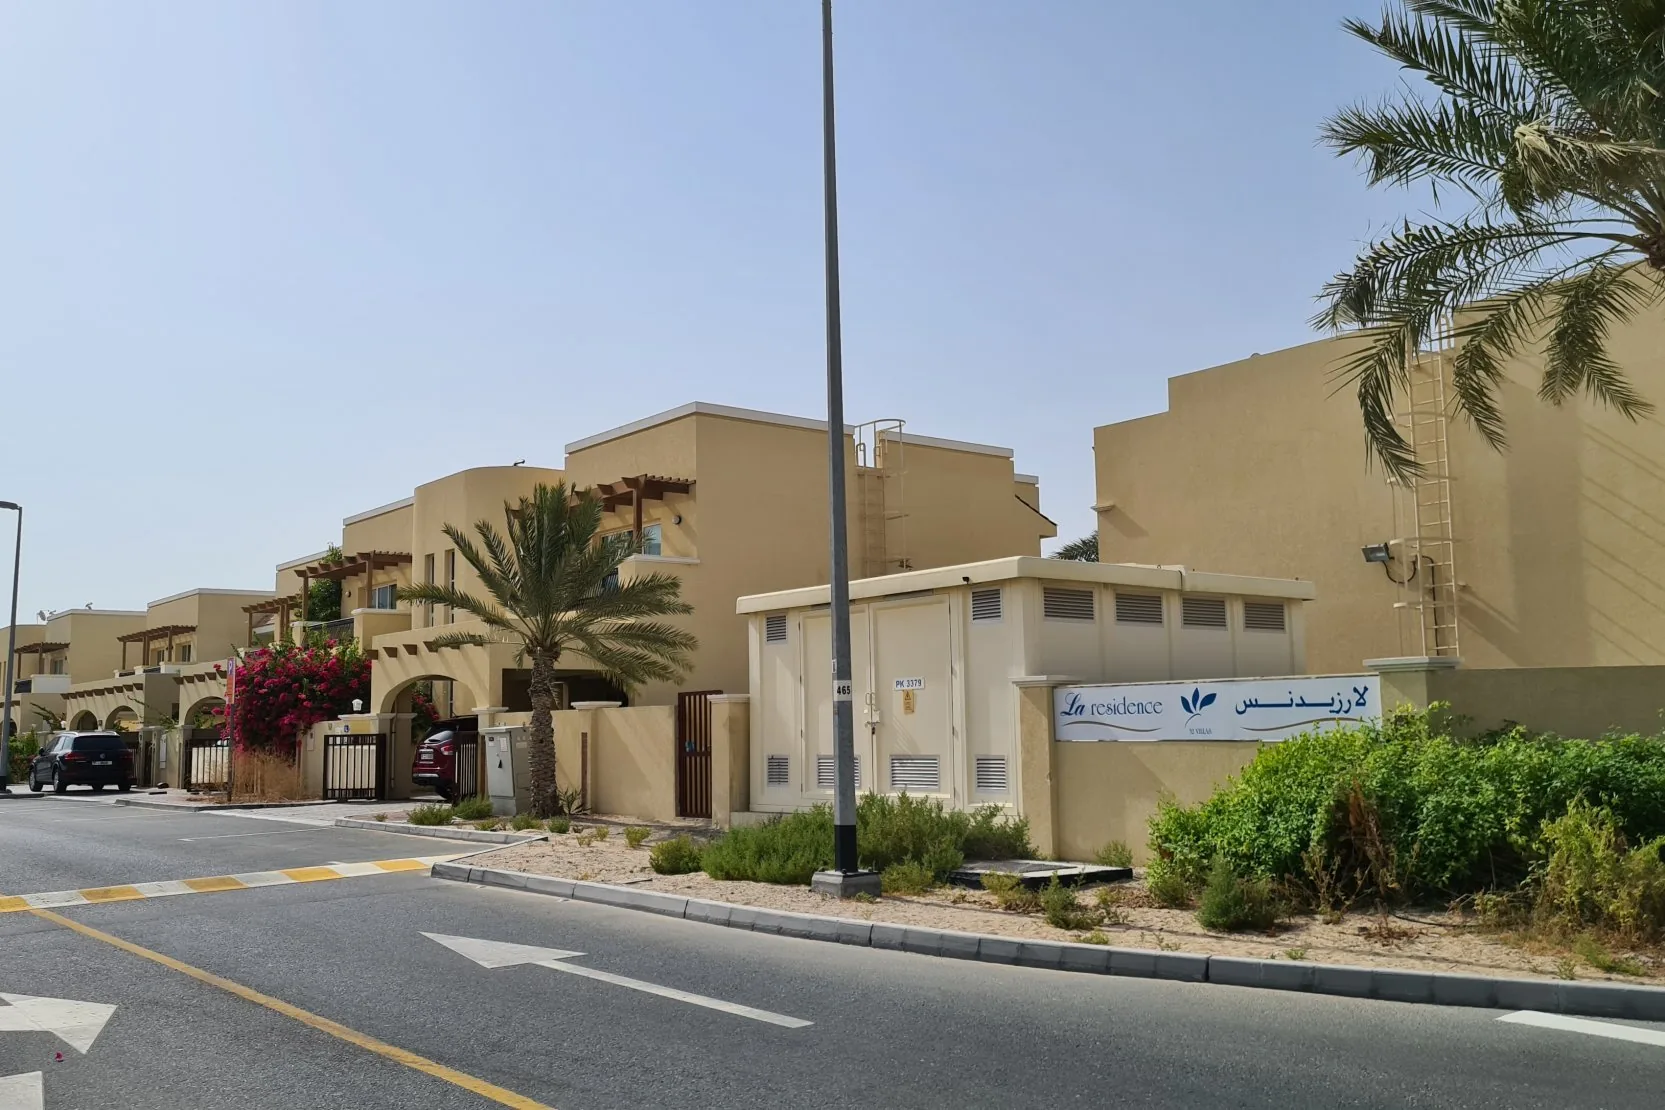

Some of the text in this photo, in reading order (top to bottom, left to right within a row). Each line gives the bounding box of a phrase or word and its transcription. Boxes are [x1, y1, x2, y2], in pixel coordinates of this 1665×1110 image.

[895, 679, 922, 688] PK 3379
[836, 685, 851, 695] 465
[1060, 692, 1163, 717] La residence
